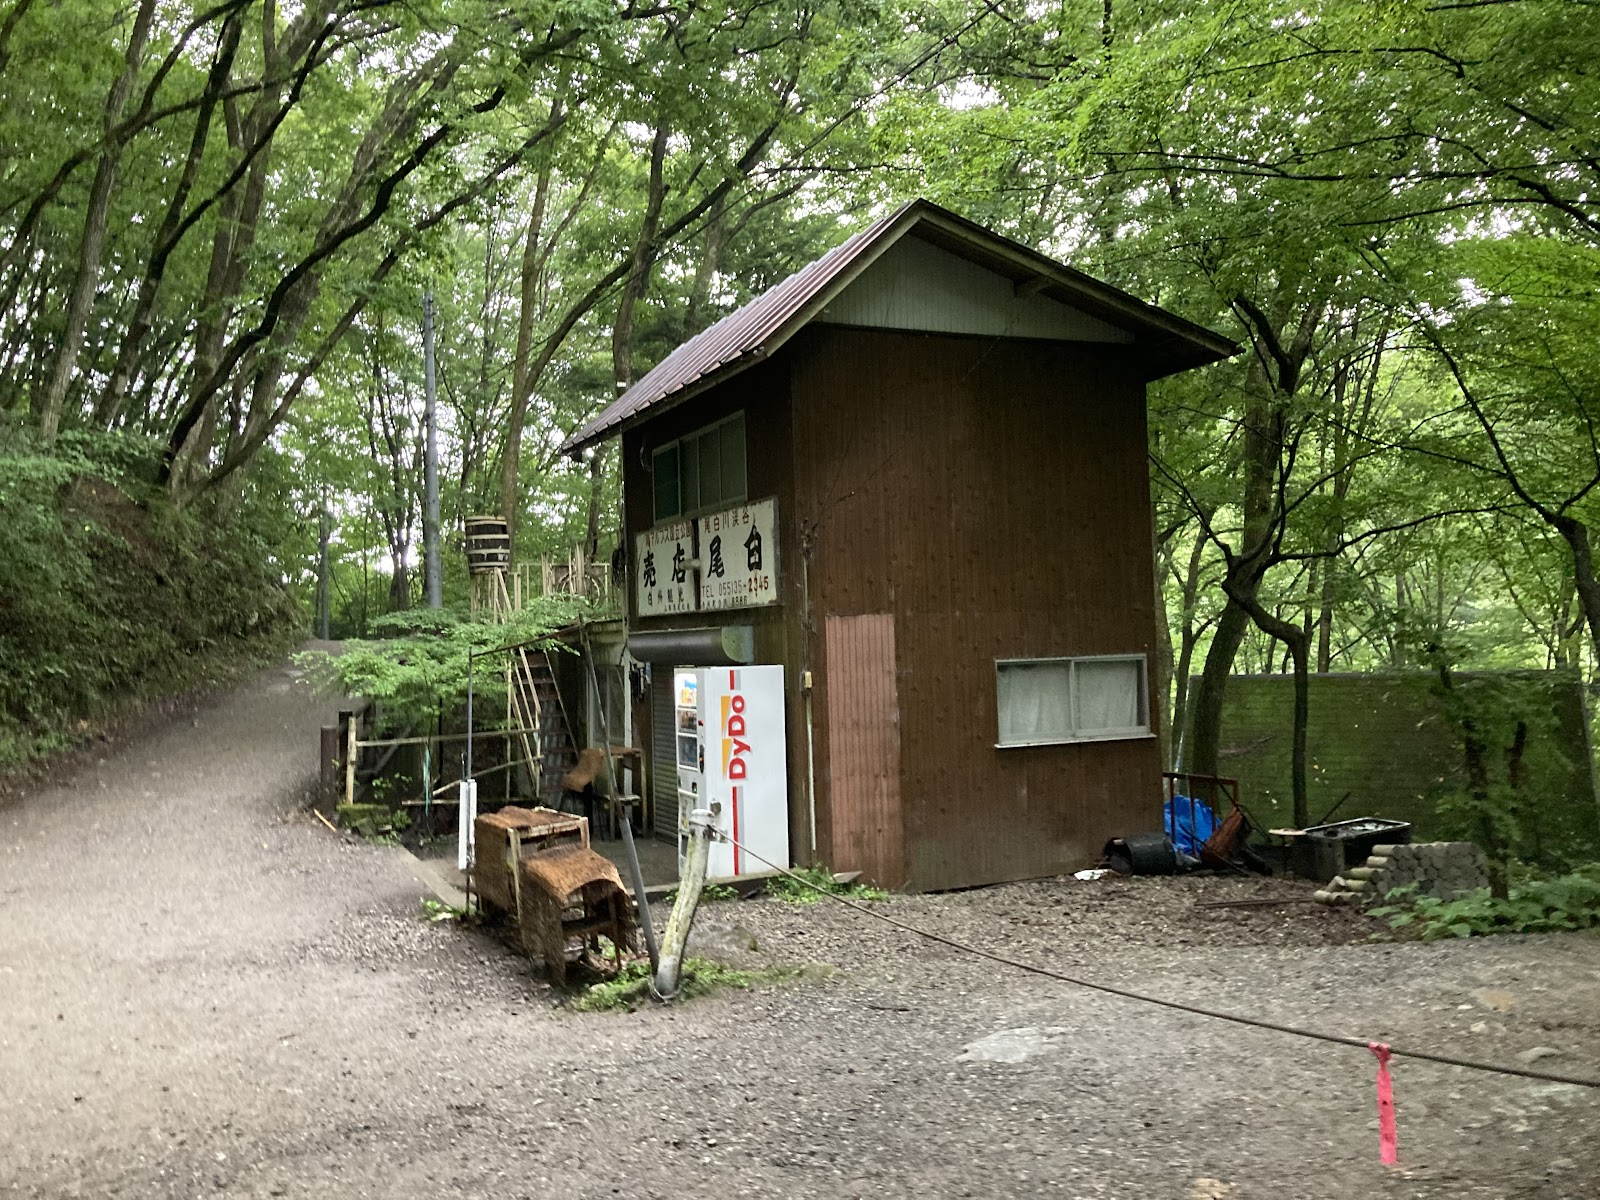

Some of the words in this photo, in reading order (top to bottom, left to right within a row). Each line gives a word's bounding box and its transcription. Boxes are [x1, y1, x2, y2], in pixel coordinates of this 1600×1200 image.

[704, 505, 750, 533] 尾白川渓谷
[643, 542, 686, 588] 売店
[701, 585, 714, 598] TEL
[727, 695, 751, 780] DyDo
